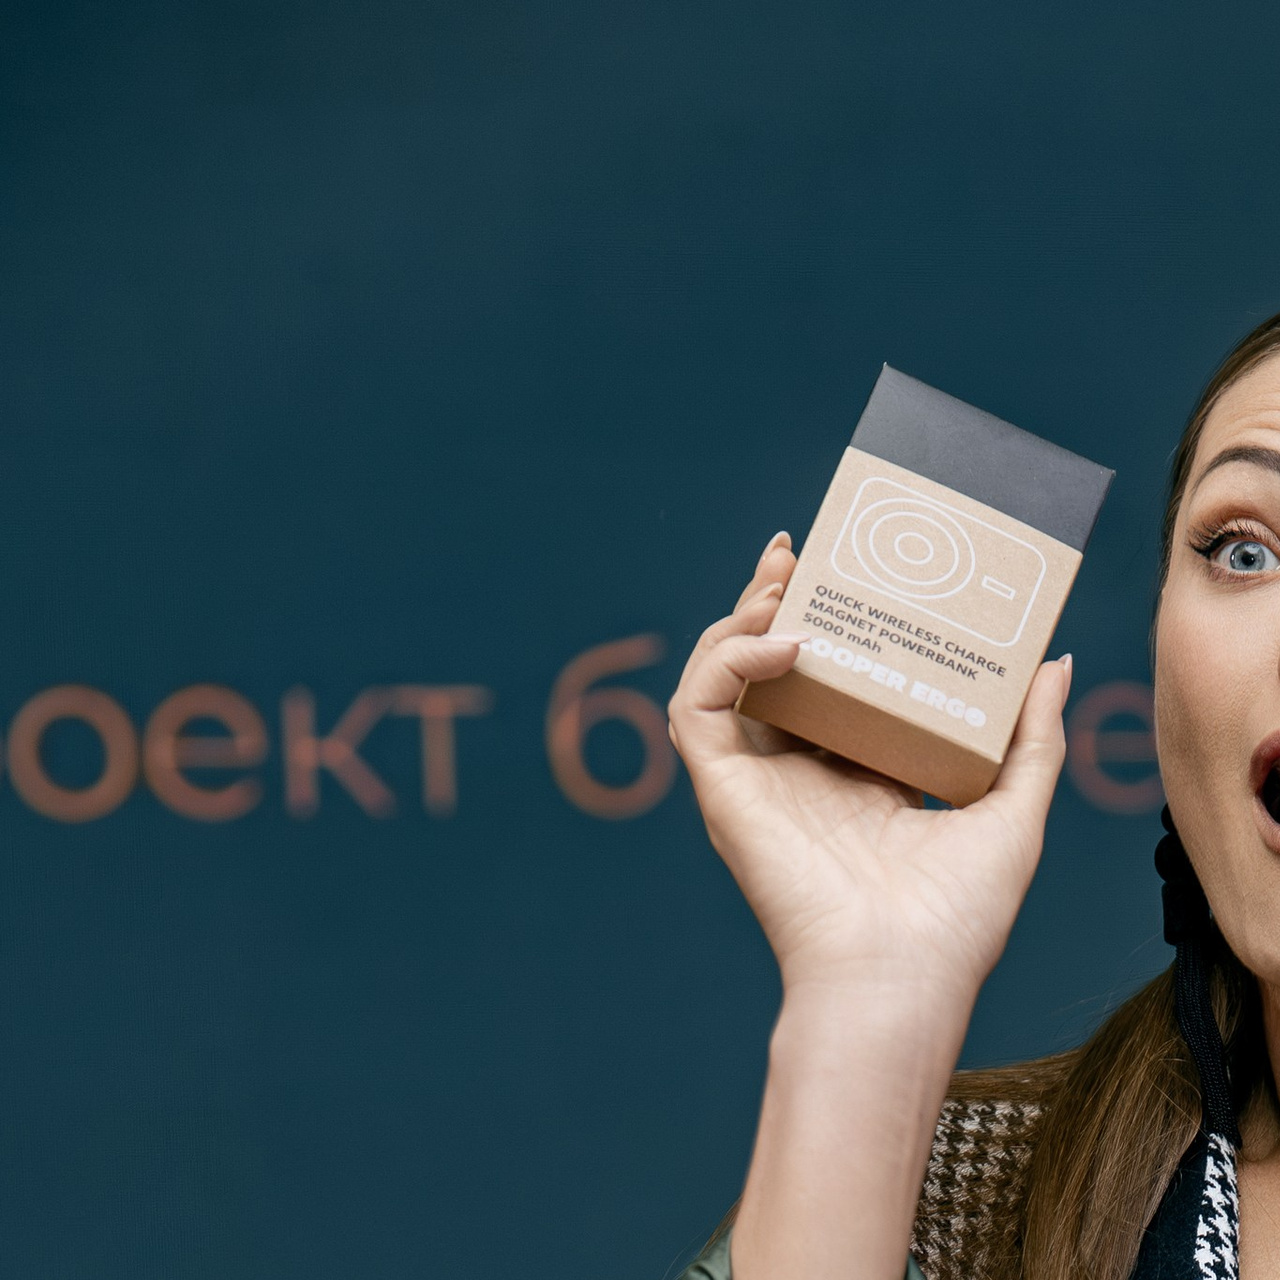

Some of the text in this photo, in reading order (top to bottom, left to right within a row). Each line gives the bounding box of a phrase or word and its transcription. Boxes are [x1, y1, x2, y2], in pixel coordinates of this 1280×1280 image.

[802, 612, 882, 654] 5000 mAh
[809, 598, 979, 681] MAGNET POWERBANK
[815, 584, 1007, 678] QUICK WIRELESS CHARGE
[910, 680, 987, 728] ERGO
